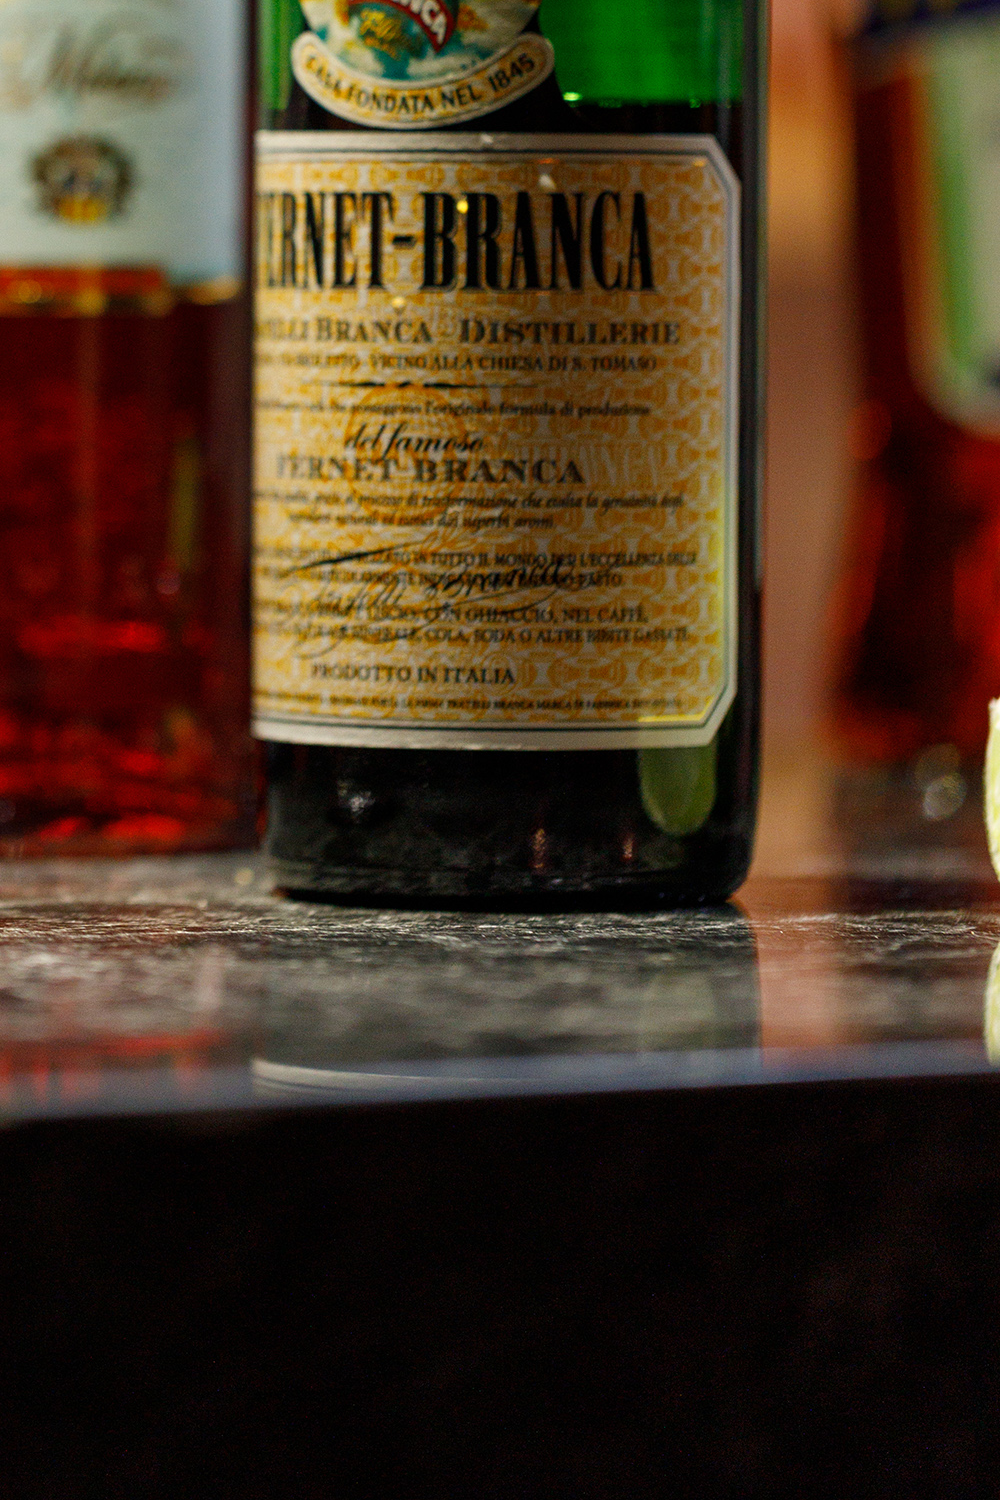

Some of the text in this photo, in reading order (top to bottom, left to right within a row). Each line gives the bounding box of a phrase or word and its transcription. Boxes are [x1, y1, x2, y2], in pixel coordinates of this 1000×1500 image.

[342, 83, 436, 116] FONDATA
[439, 81, 484, 109] NEL
[485, 53, 537, 93] 1845
[316, 317, 433, 344] BRANCA
[459, 318, 680, 346] DISTILLERIE
[478, 356, 542, 372] CHIESA
[344, 420, 486, 462] del famoso
[415, 666, 438, 685] IN
[442, 666, 517, 686] ITALIA
